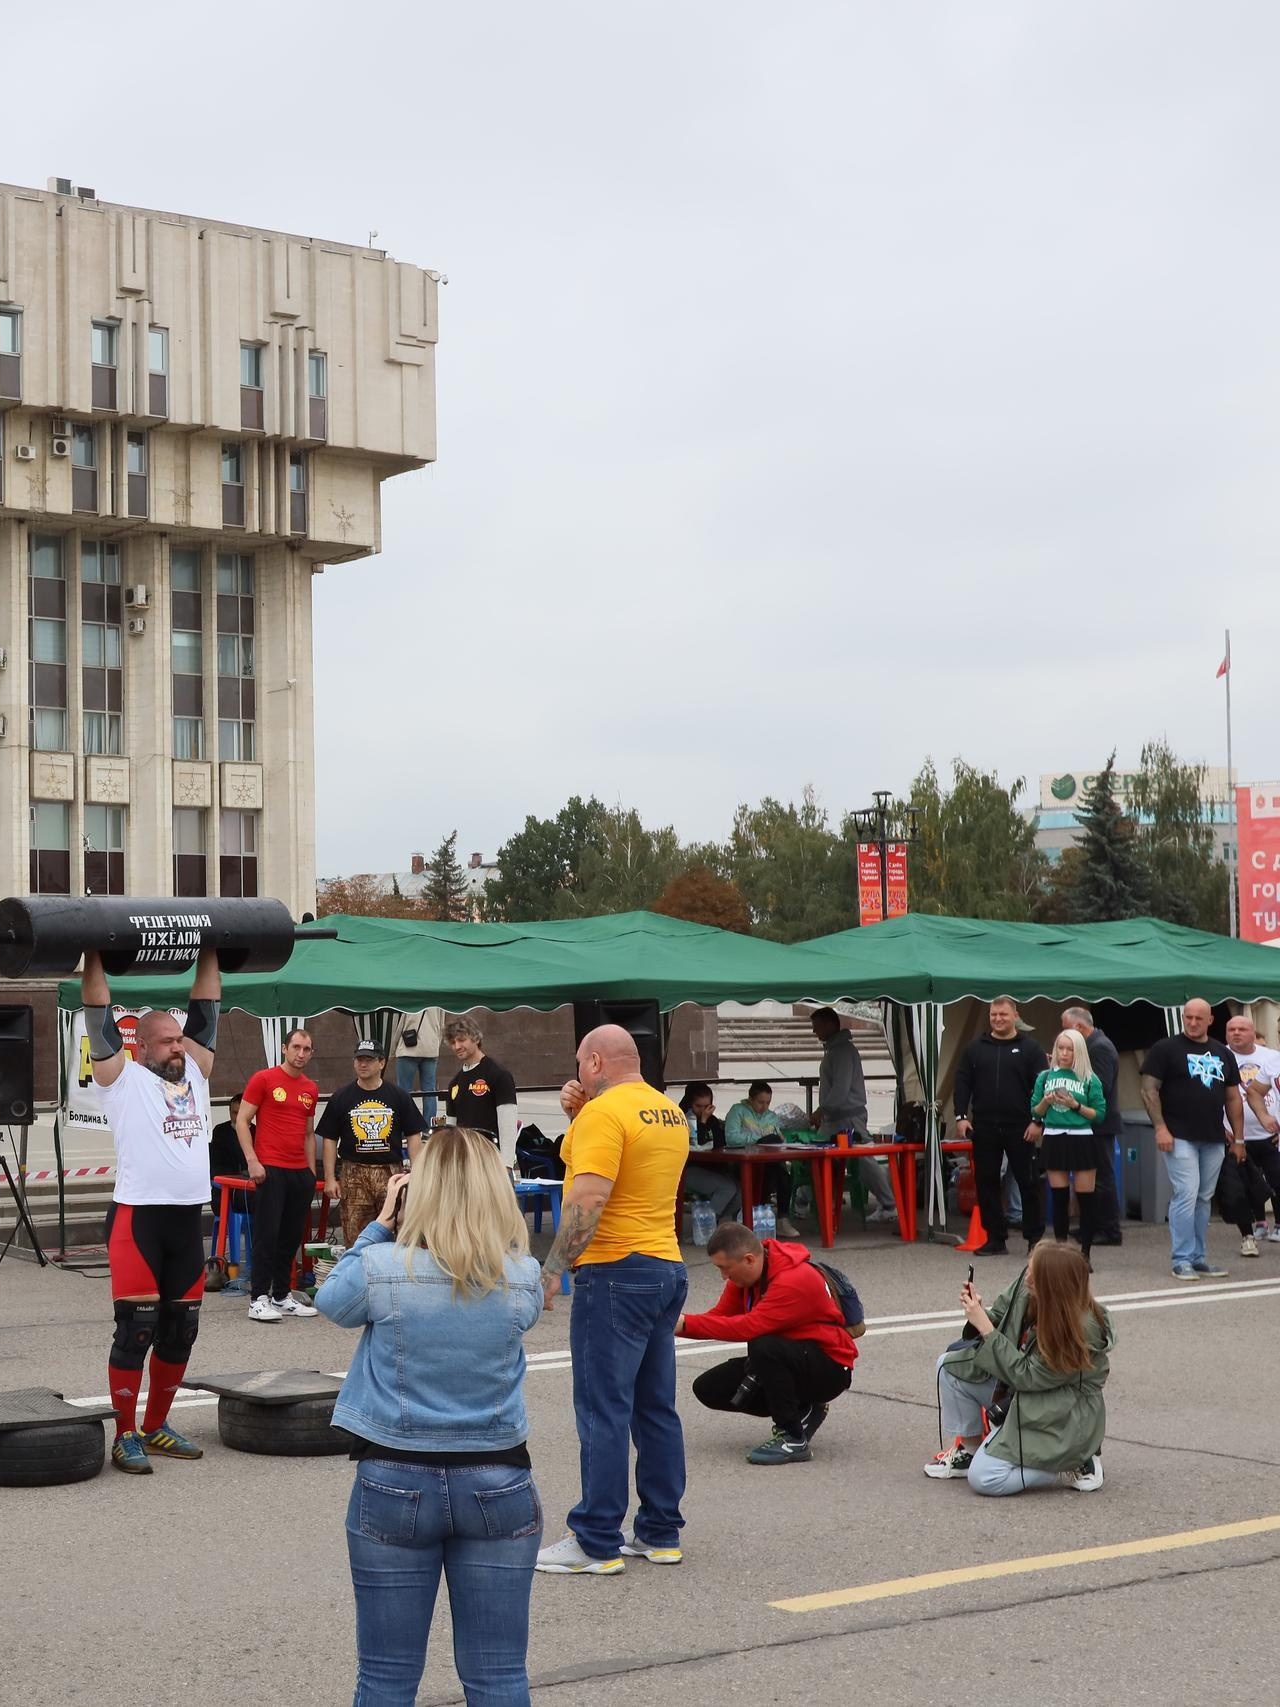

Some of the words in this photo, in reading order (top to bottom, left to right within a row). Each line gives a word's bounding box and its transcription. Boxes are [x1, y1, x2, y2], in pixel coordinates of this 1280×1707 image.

[1251, 850, 1266, 870] С
[129, 915, 212, 929] ФЕДЕРАЦИЯ
[140, 929, 201, 946] ТЯЖЁЛОЙ
[135, 948, 200, 962] АТЛЕТИКИ
[1045, 1077, 1085, 1096] CALIFORNIA
[69, 1110, 102, 1124] Болдина
[639, 1108, 688, 1127] СУДЬЯ
